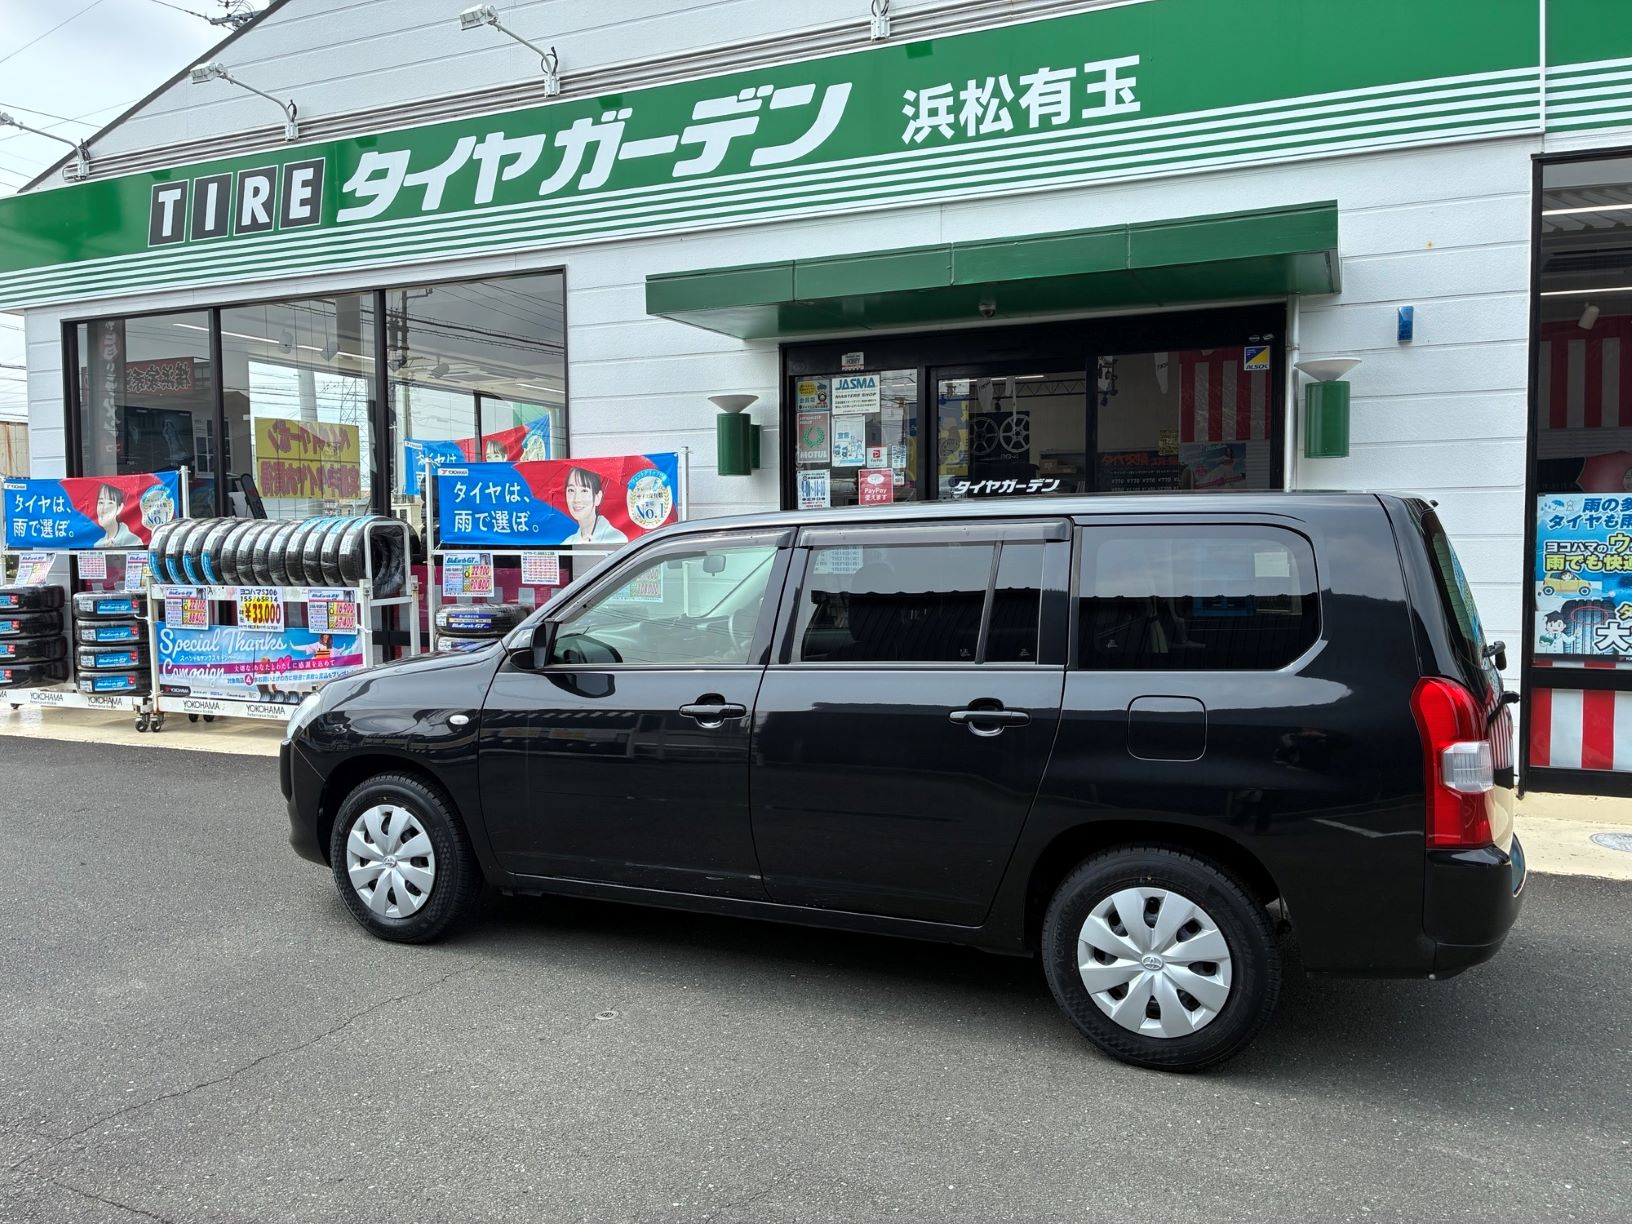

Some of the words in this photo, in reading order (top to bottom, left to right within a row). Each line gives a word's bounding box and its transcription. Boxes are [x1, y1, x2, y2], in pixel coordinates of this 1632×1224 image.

[158, 167, 314, 237] TIRE
[336, 82, 852, 222] タイヤガーデン
[902, 54, 1141, 145] 浜松有玉
[835, 377, 876, 391] JASMA
[800, 450, 828, 459] MOTUL
[454, 481, 530, 504] タイヤは、
[864, 487, 888, 495] PayPay
[954, 478, 1061, 495] タイヤガーデン
[15, 493, 72, 514] タイヤは、
[1545, 532, 1632, 554] ヨコハマのウ
[240, 588, 278, 596] ヨコハマS306
[245, 603, 281, 624] ¥33,000
[160, 628, 221, 659] Special
[222, 628, 288, 654] Thanks
[1594, 621, 1632, 652] 大
[163, 658, 225, 688] Campaign
[30, 692, 64, 702] YOKOHAMA
[88, 696, 123, 706] YOKOHAMA
[183, 700, 221, 710] YOKOHAMA
[246, 704, 286, 715] YOKOHAMA
